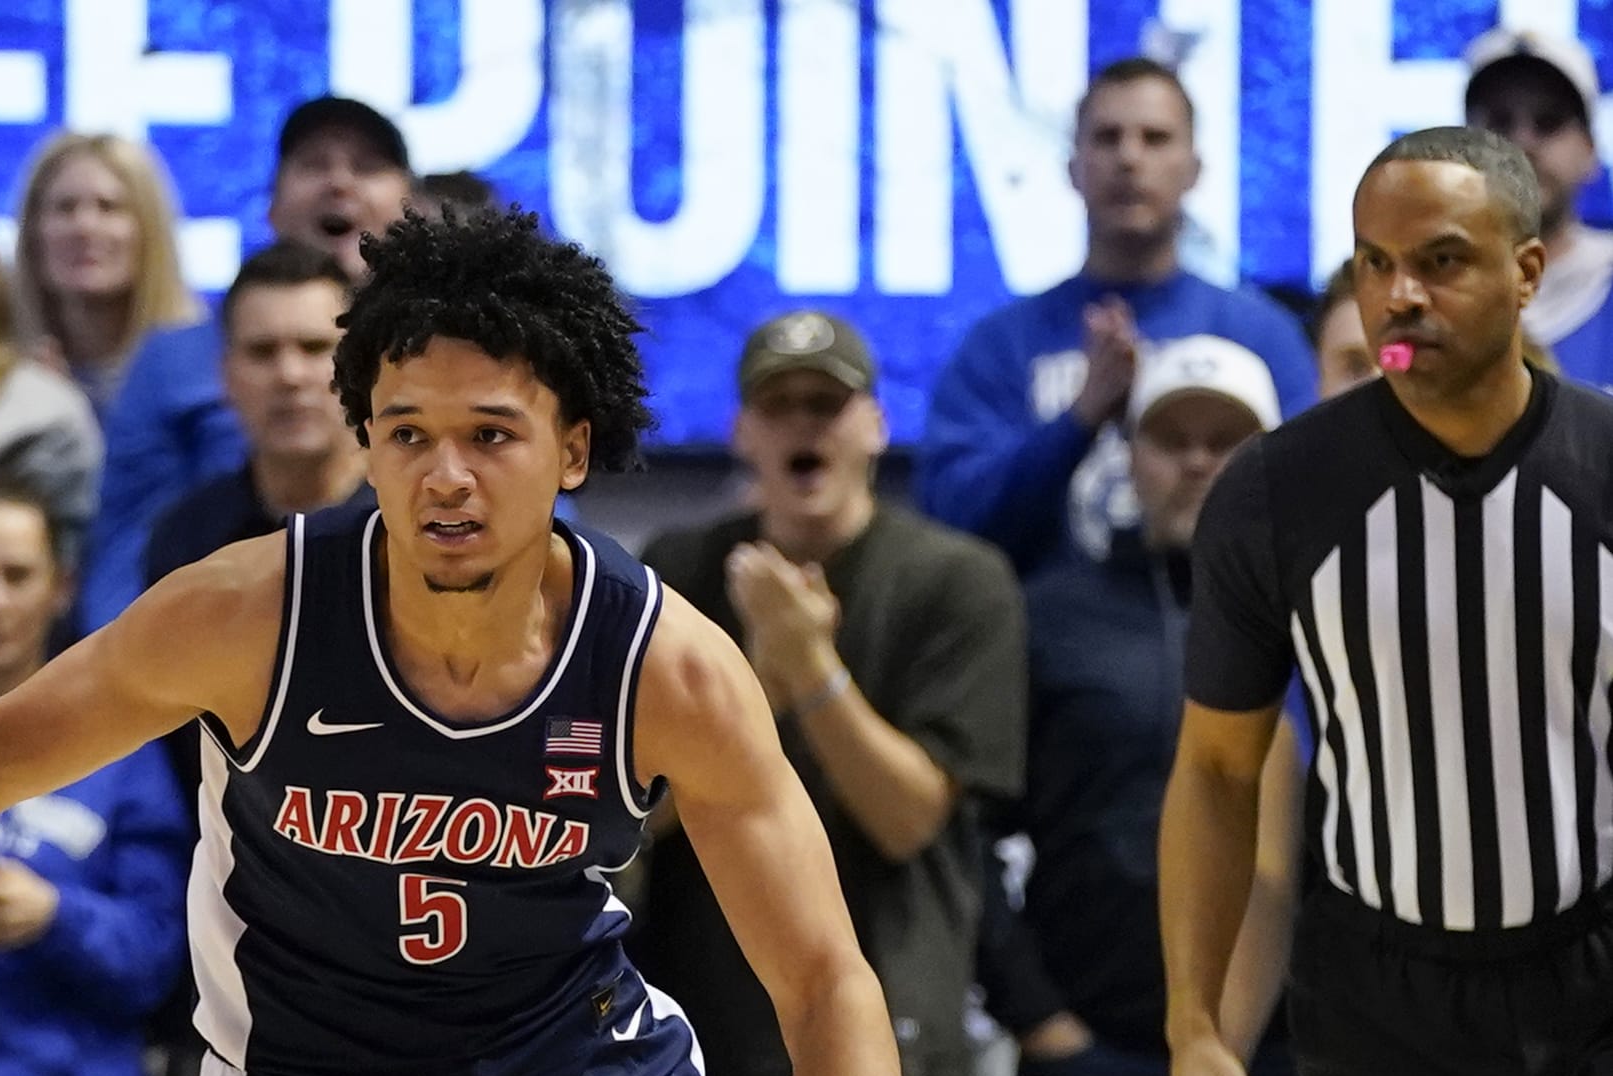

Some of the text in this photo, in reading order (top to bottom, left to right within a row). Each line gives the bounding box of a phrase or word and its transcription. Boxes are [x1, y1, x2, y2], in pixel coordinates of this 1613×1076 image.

[330, 0, 1613, 298] POINE
[546, 767, 597, 796] XII
[273, 786, 589, 868] ARIZONA
[399, 873, 468, 965] 5
